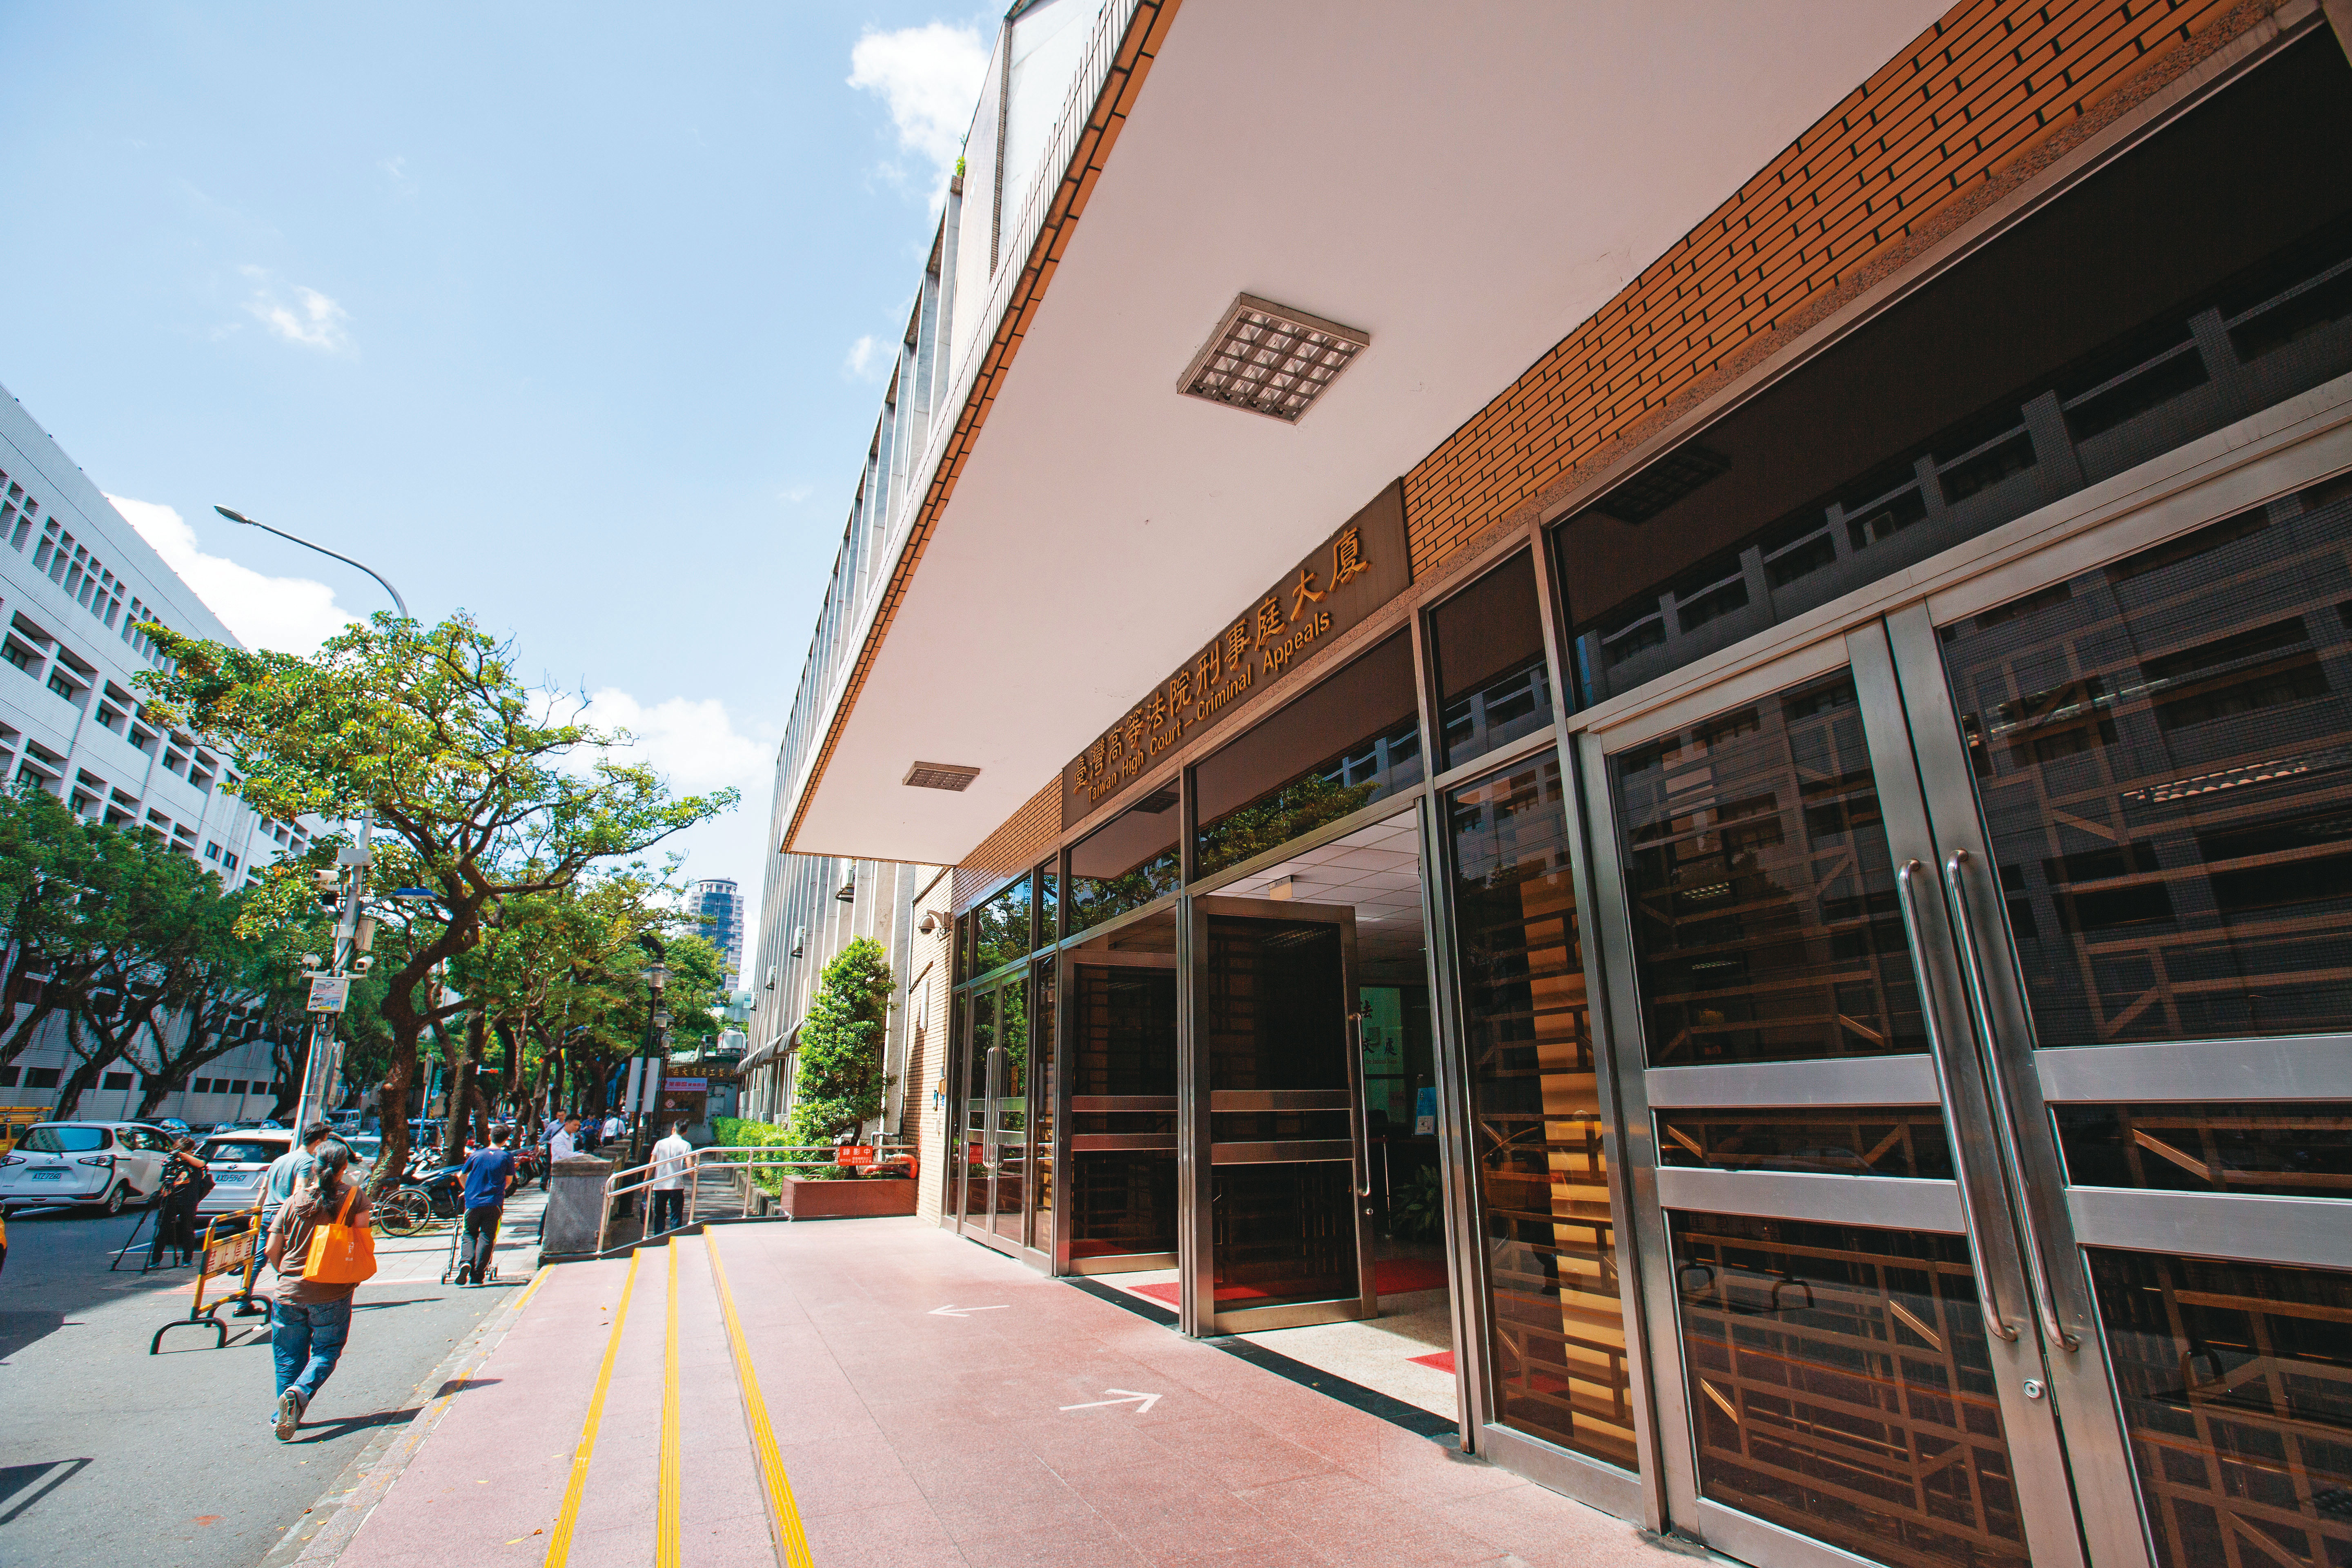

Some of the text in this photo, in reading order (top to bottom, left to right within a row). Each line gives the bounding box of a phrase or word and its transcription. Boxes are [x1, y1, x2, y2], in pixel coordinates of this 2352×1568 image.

[1074, 527, 1371, 794] 臺灣高等法院刑事庭大廈
[1088, 772, 1119, 803] Taiwan
[1123, 749, 1145, 777] High
[1150, 718, 1183, 755] Court
[1197, 664, 1253, 721] Criminal
[1263, 612, 1332, 675] Appeals
[206, 1236, 254, 1273] 禁止停車
